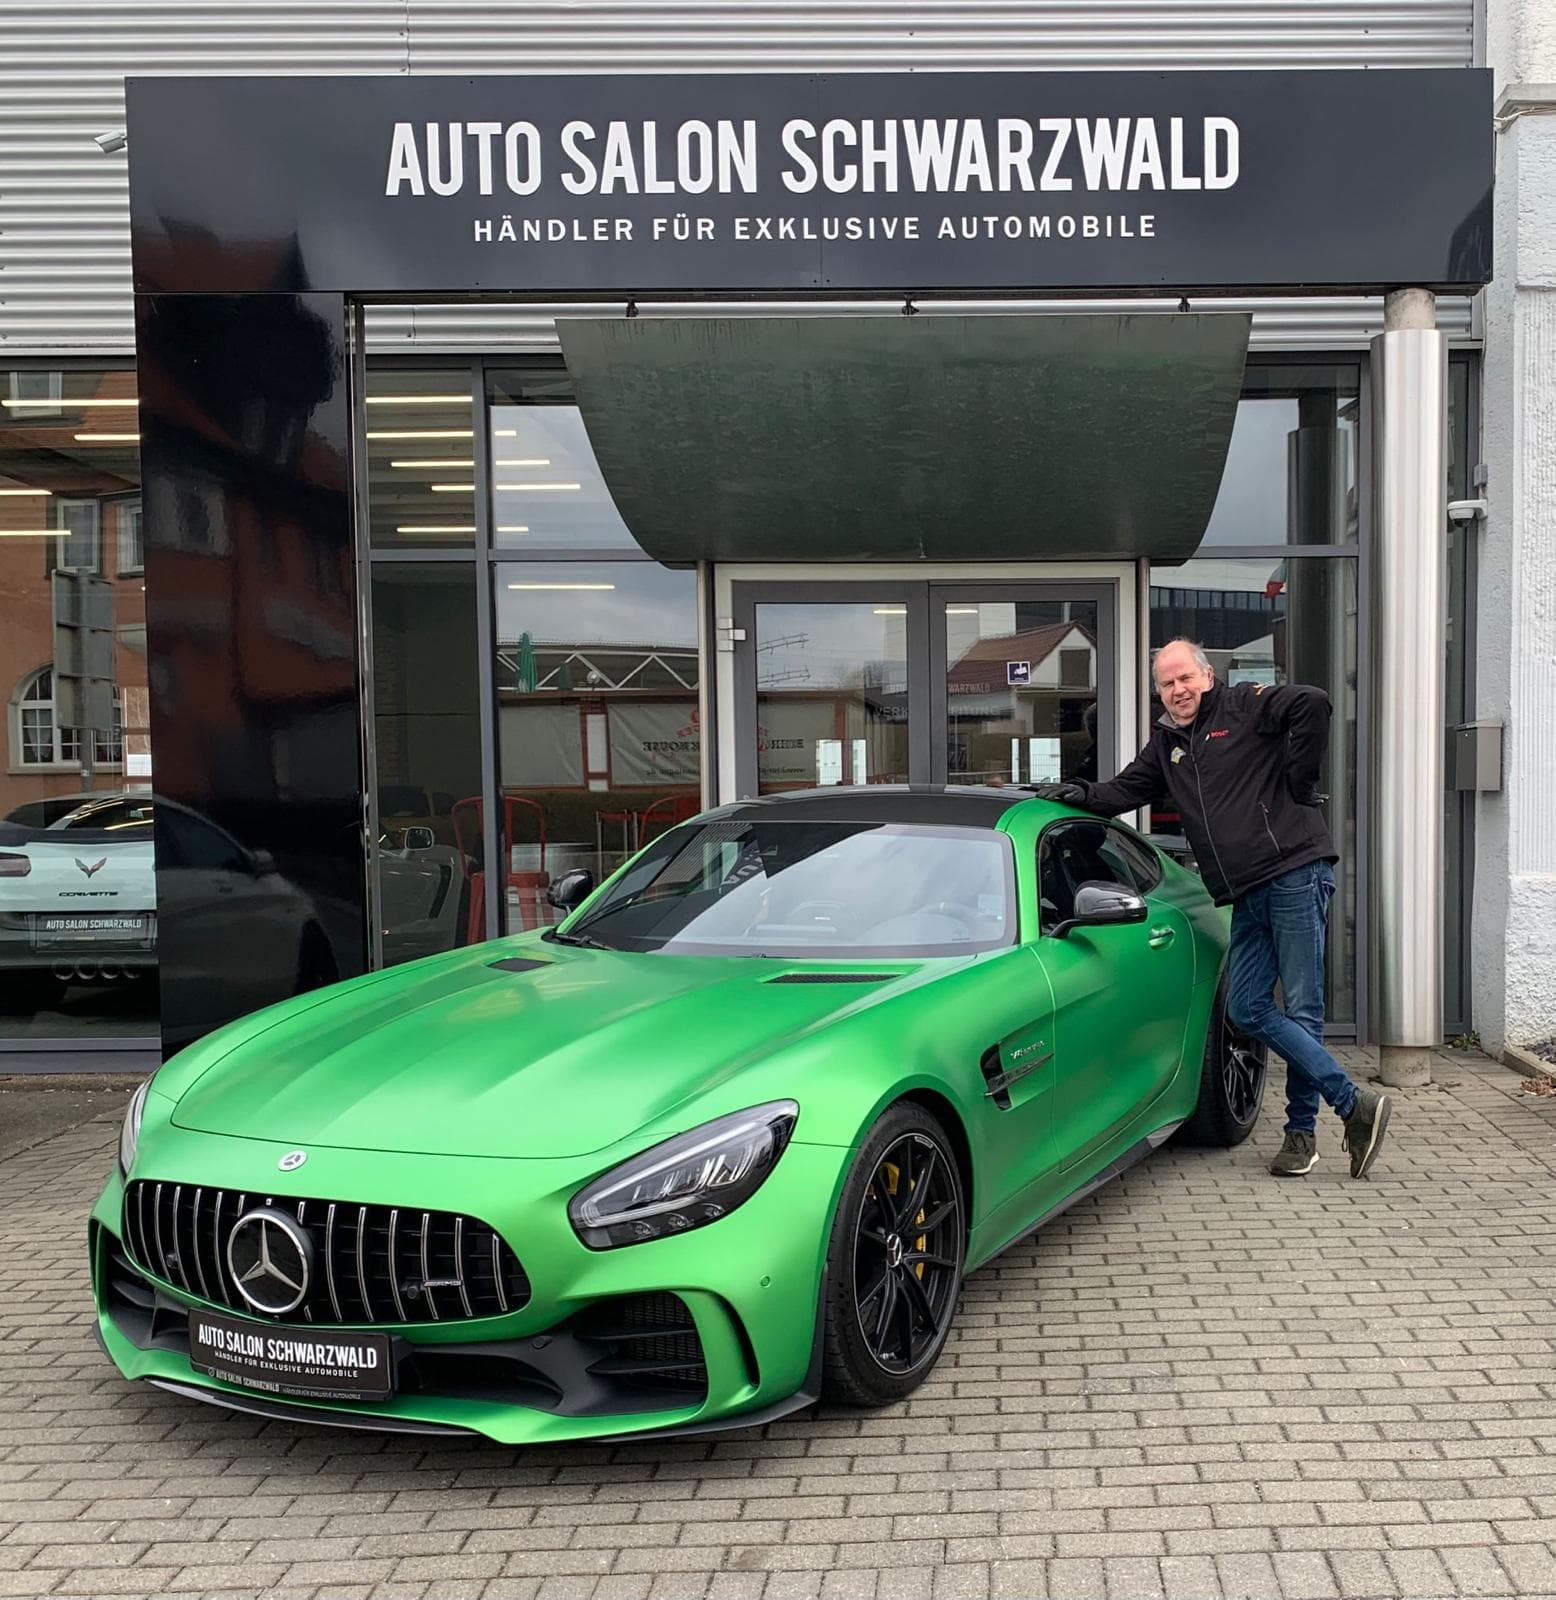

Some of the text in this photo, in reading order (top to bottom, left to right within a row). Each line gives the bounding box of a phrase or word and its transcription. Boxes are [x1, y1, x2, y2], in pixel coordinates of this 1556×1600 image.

[385, 116, 1240, 196] AUTO SALON SCHWARZWALD
[474, 212, 1155, 242] HÄNDLER FÜR EXKLUSIVE AUTOMOBILE
[46, 919, 142, 929] AUTO SALON SCHWARZWALD
[198, 1323, 377, 1369] AUTO SALON SCHWARZWALD
[260, 1361, 302, 1373] EXKLUSIVE
[304, 1367, 358, 1378] AUTOMOBILE
